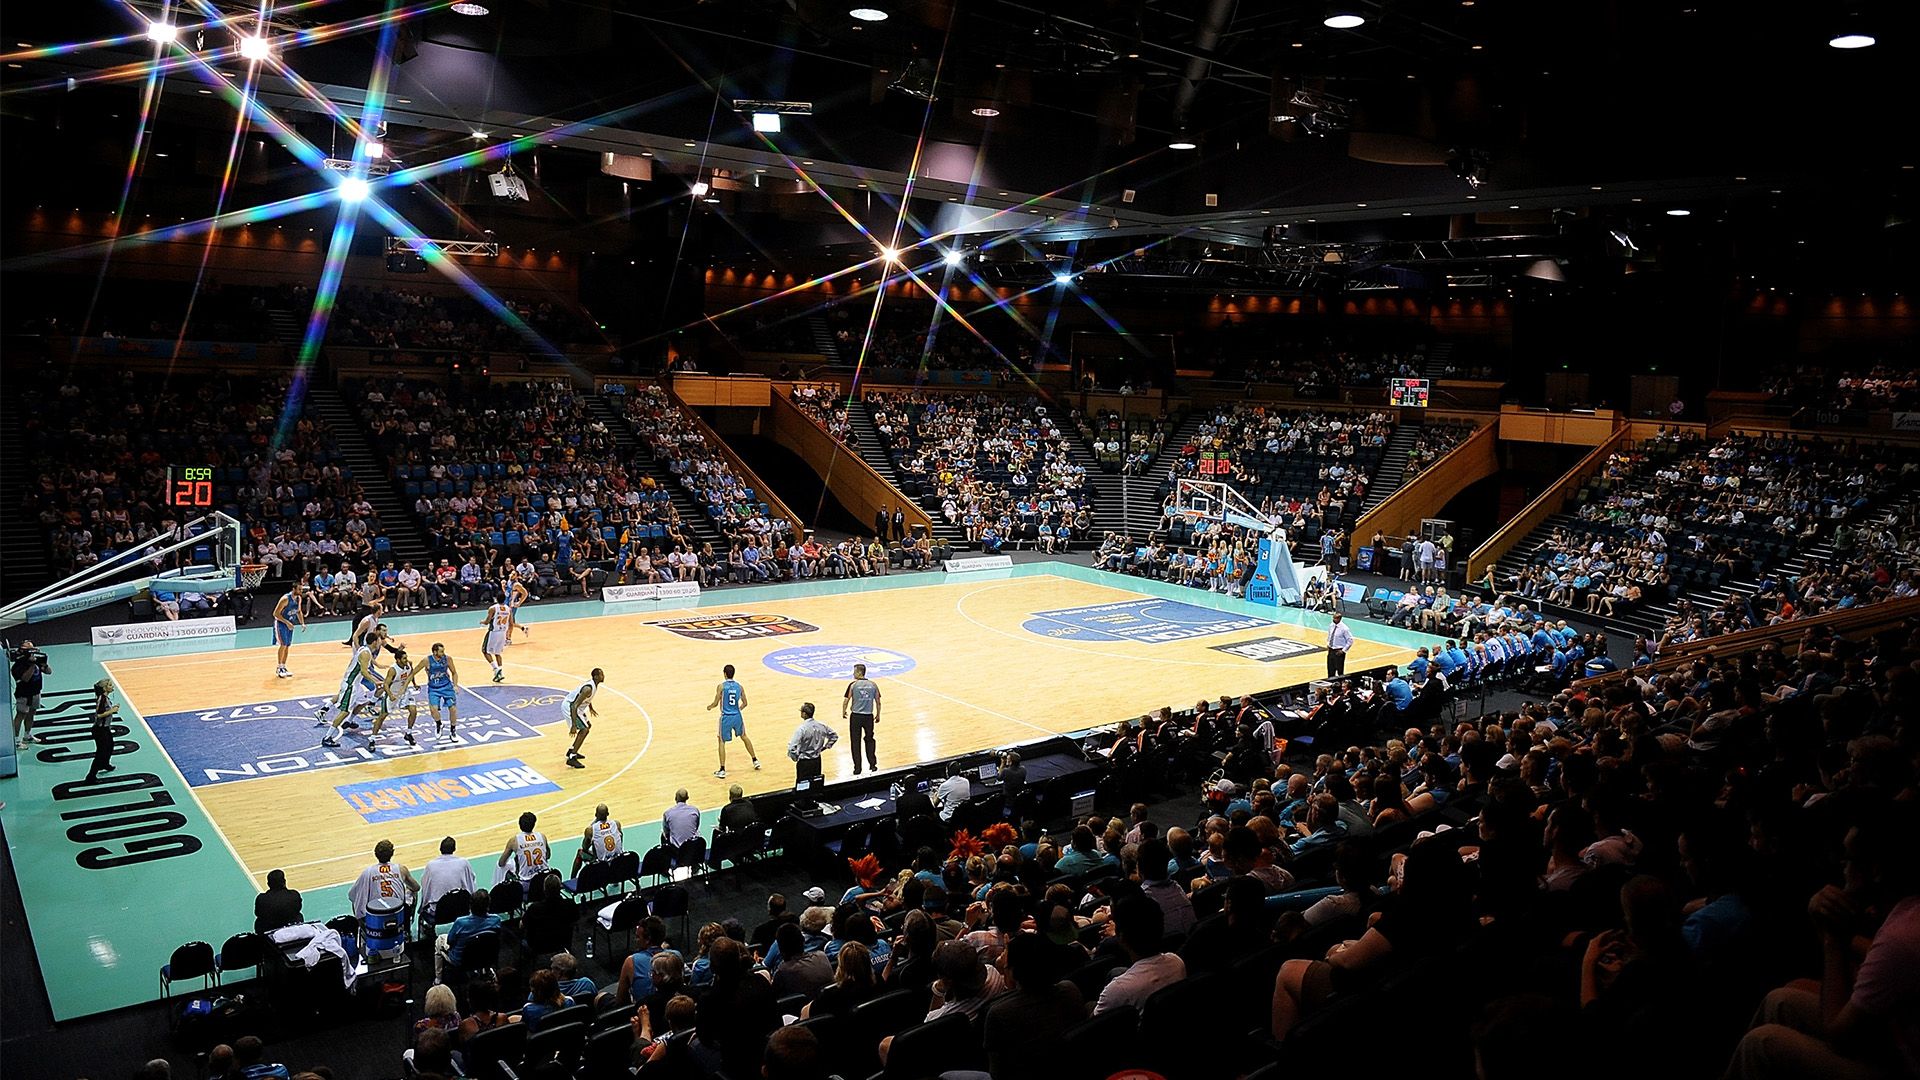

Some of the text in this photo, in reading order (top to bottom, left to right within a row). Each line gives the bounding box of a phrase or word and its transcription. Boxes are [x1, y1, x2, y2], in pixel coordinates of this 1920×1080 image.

[185, 467, 212, 481] 8:59
[1199, 459, 1215, 474] 20
[1216, 459, 1230, 474] 20
[175, 481, 212, 506] 20
[125, 624, 169, 634] INSOLVENCY
[126, 631, 170, 641] GUARDIAN
[176, 625, 232, 637] 1300 60 70 60
[728, 694, 736, 706] 5
[195, 704, 279, 722] 672
[204, 727, 521, 782] MERITON
[51, 772, 203, 870] GOLD
[603, 835, 616, 852] 8
[523, 847, 543, 867] 12
[380, 880, 394, 897] 5
